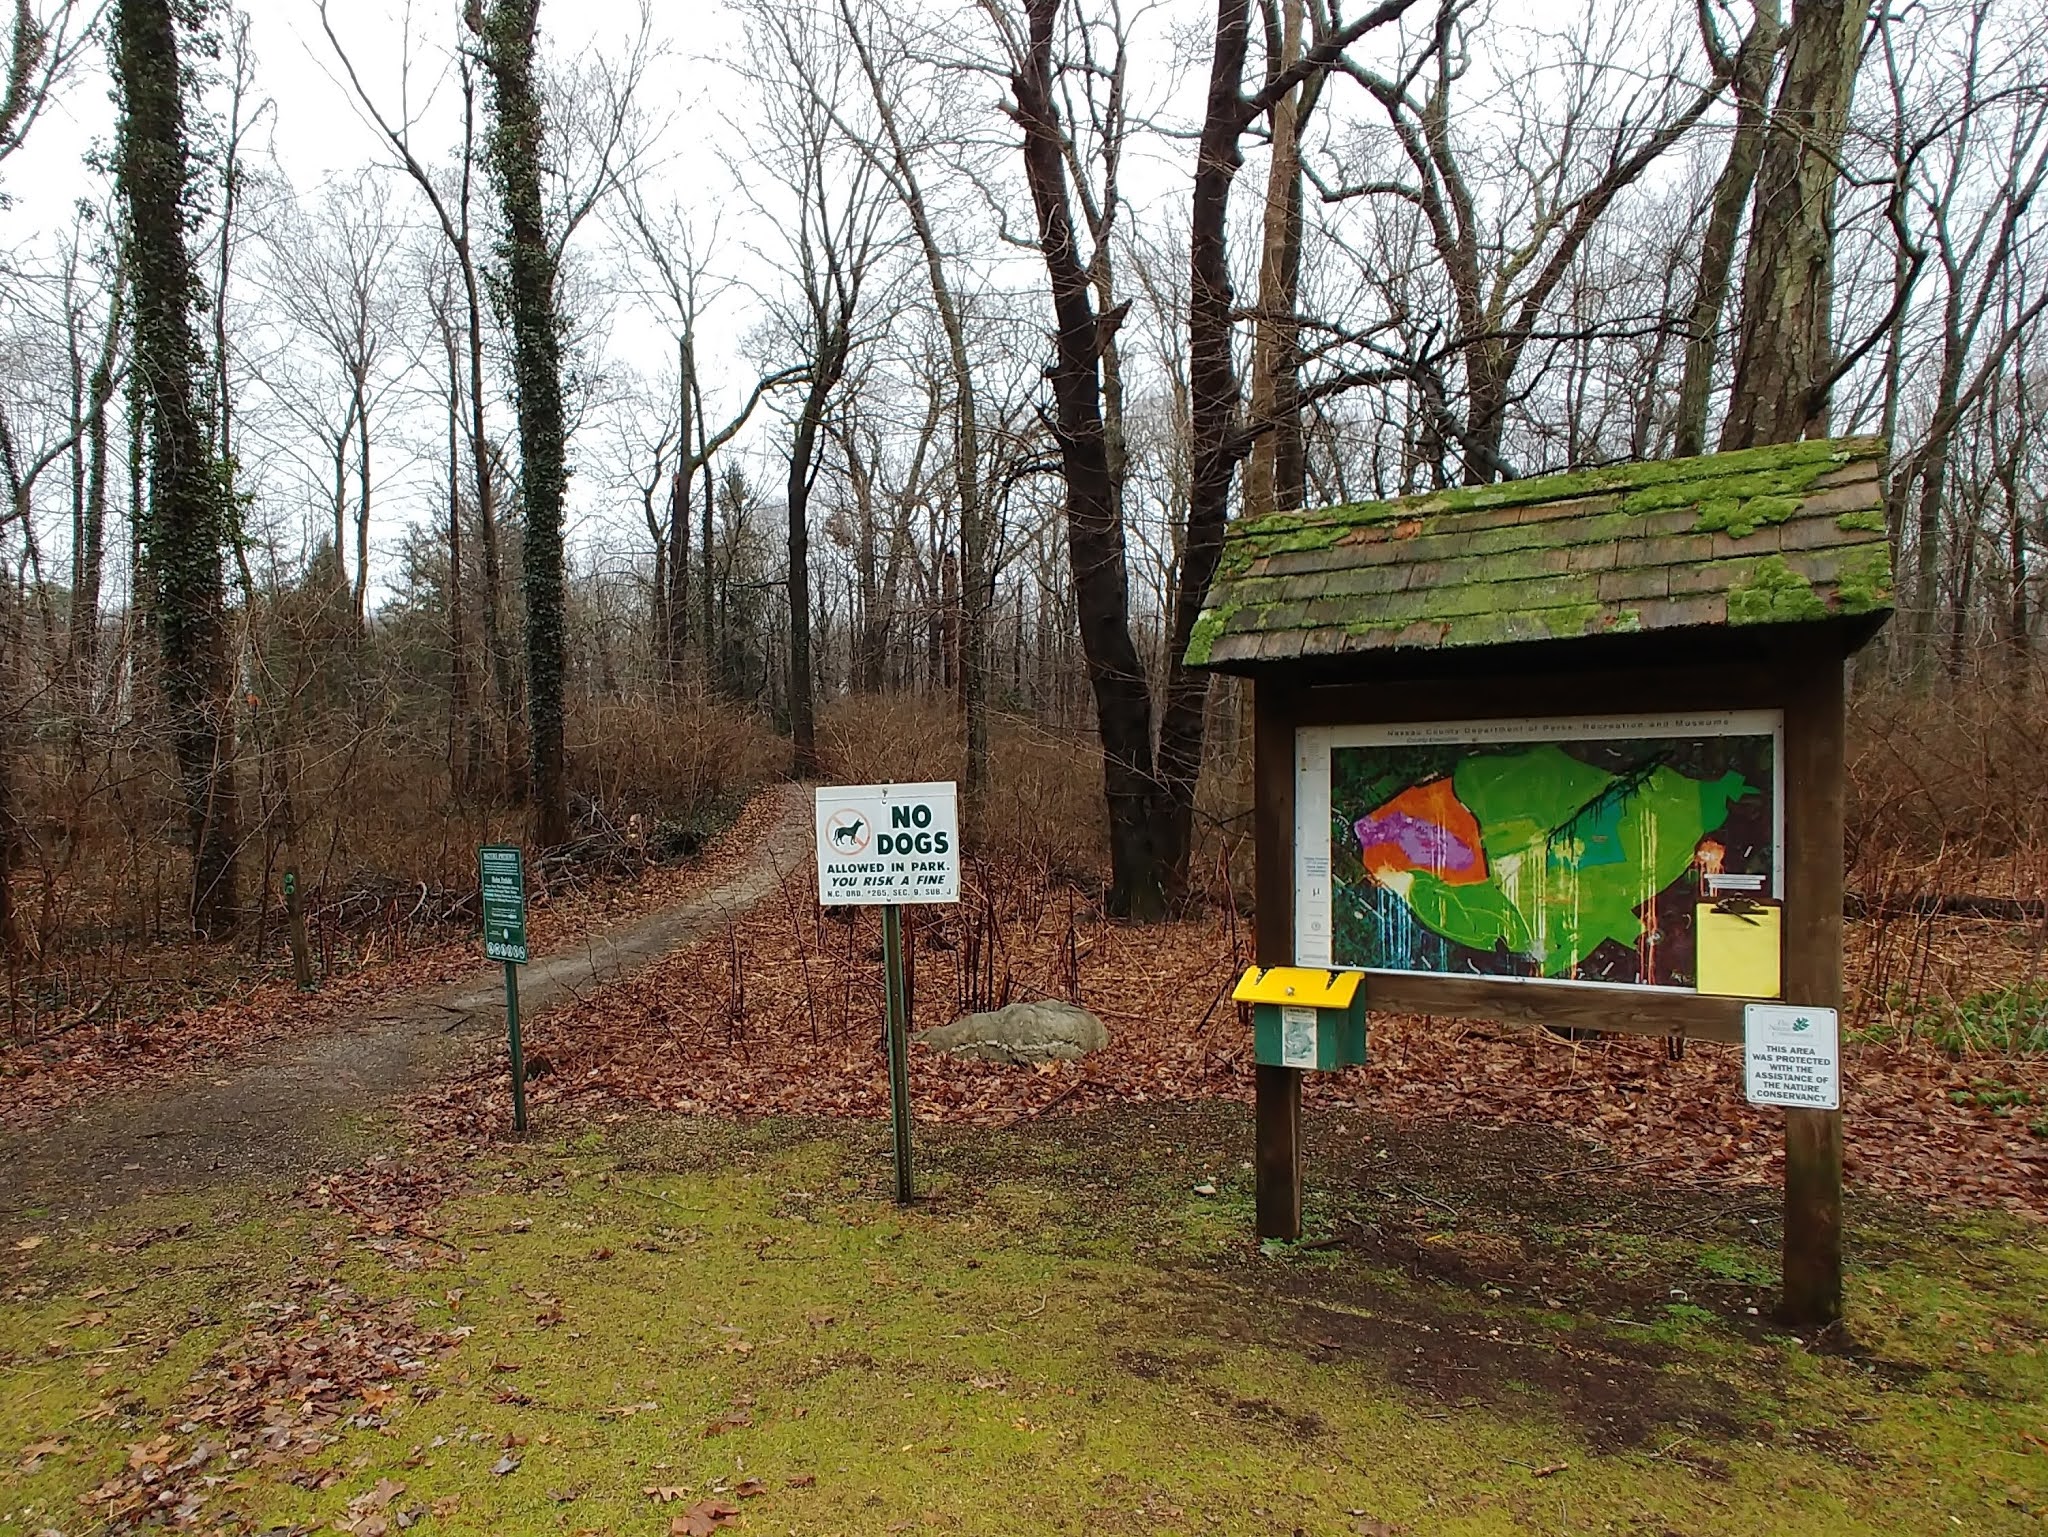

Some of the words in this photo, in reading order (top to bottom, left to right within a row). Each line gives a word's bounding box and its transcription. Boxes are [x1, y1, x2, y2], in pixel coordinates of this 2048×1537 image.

[1464, 725, 1523, 735] Department
[1582, 722, 1643, 730] Recreation
[1675, 719, 1729, 727] Museums
[891, 804, 932, 829] NO
[877, 831, 949, 855] DOGS
[827, 863, 885, 874] ALLOWED
[891, 862, 905, 872] IN
[911, 861, 951, 872] PARK.
[832, 877, 858, 887] YOU
[863, 876, 895, 886] RISK
[900, 875, 909, 886] A
[916, 875, 946, 885] FINE
[827, 890, 843, 898] N.C.
[846, 889, 864, 897] ORD.
[893, 888, 910, 896] SEC.
[1766, 1045, 1787, 1053] THIS
[1790, 1047, 1816, 1055] AREA
[1752, 1053, 1773, 1062] WAS
[1776, 1056, 1831, 1066] PROTECTED
[1769, 1064, 1793, 1072] WITH
[1796, 1066, 1813, 1074] THE
[1755, 1072, 1813, 1083] ASSISTANCE
[1816, 1076, 1829, 1084] OF
[1763, 1081, 1780, 1089] THE
[1783, 1083, 1820, 1093] NATURE
[1756, 1090, 1827, 1102] CONSERVANCY
